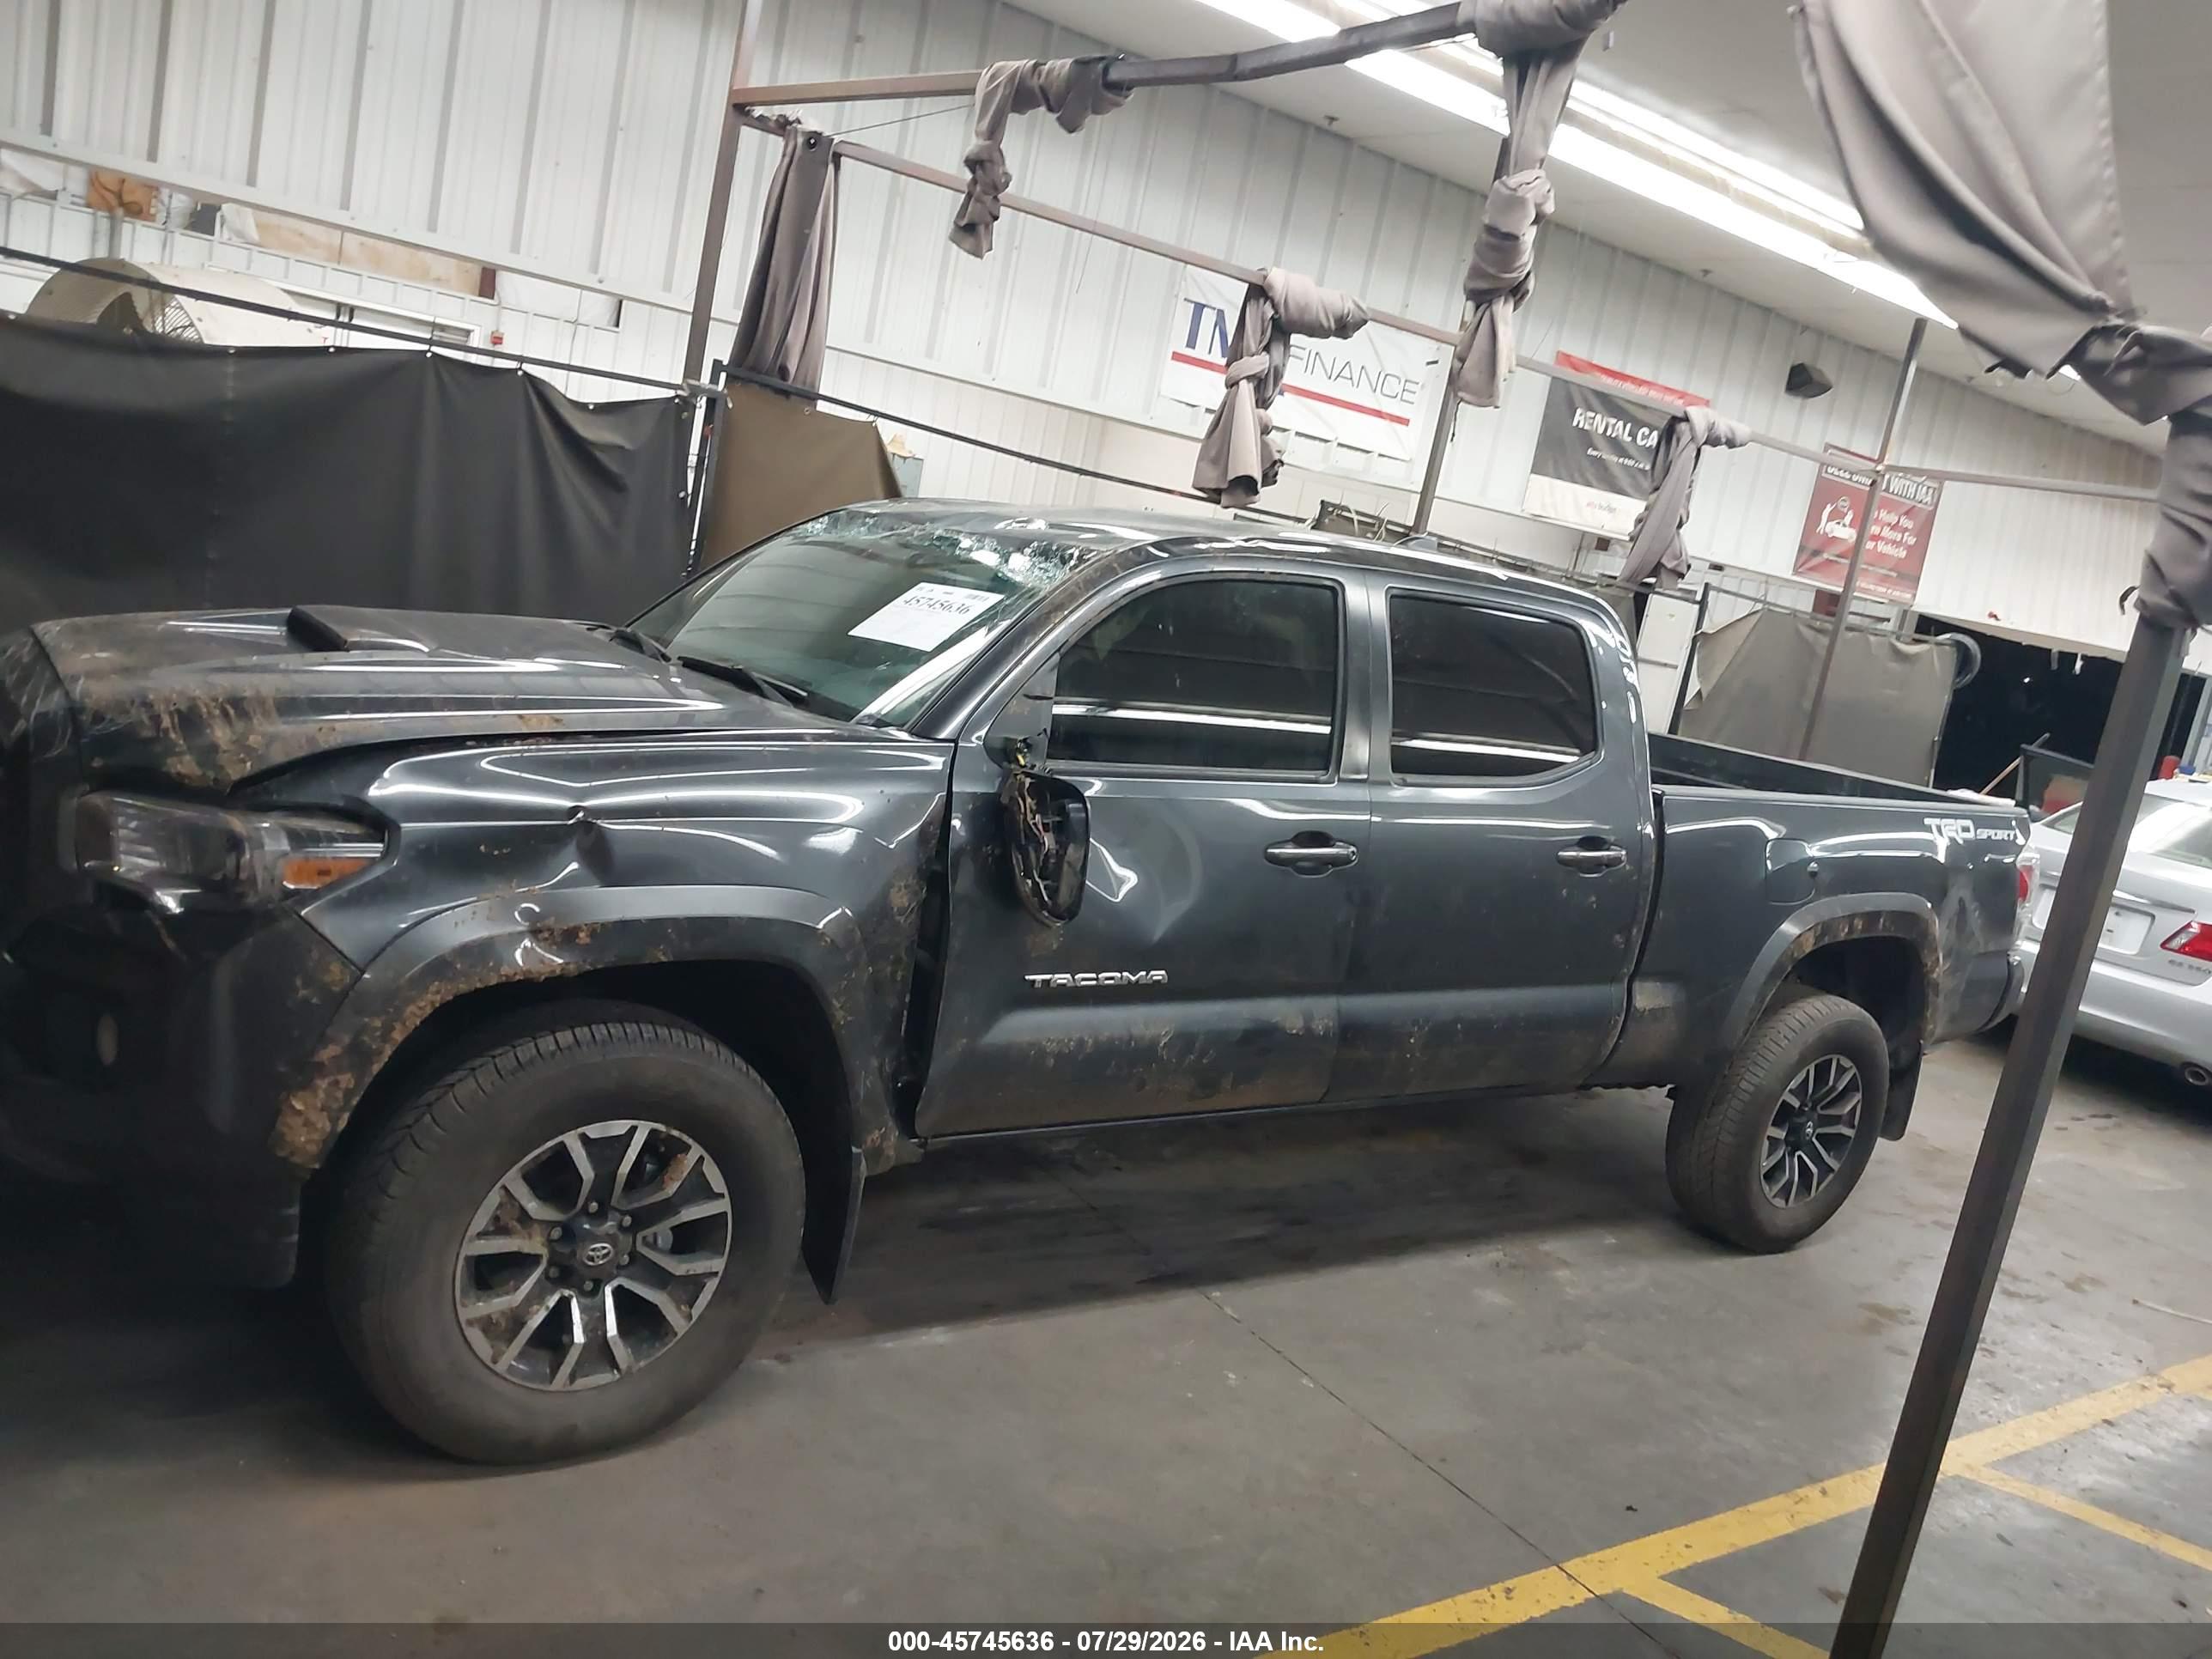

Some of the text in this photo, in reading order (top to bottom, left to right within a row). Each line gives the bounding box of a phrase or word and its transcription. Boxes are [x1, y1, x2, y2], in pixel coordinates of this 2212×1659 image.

[1572, 407, 1659, 449] RENTAL CA
[1889, 475, 1916, 500] WITH
[1879, 508, 1914, 530] Help You
[1880, 525, 1902, 543] More
[1903, 532, 1917, 545] For
[1876, 540, 1907, 559] Vehicle
[902, 595, 974, 615] 45745636
[1923, 817, 2016, 845] TRD SPORT
[1024, 969, 1169, 988] TACOMA
